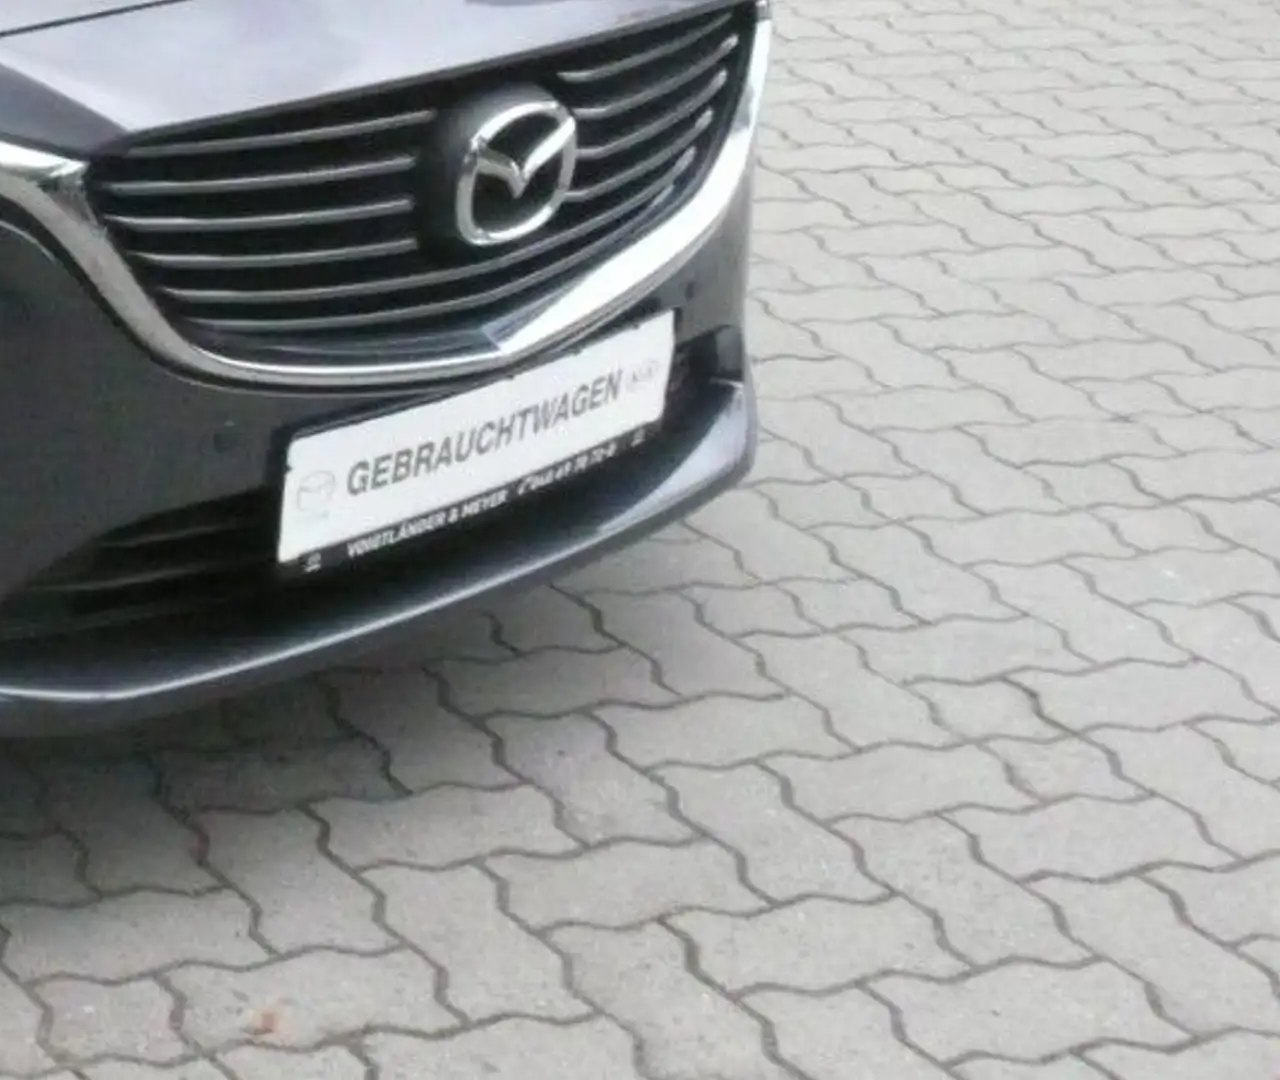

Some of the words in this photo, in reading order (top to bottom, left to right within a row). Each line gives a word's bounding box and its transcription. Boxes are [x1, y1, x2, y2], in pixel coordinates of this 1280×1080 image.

[346, 369, 623, 495] GEBRAUCHTWAGEN
[346, 510, 446, 558] VOIGTLÄNDER
[461, 489, 508, 519] MEYER
